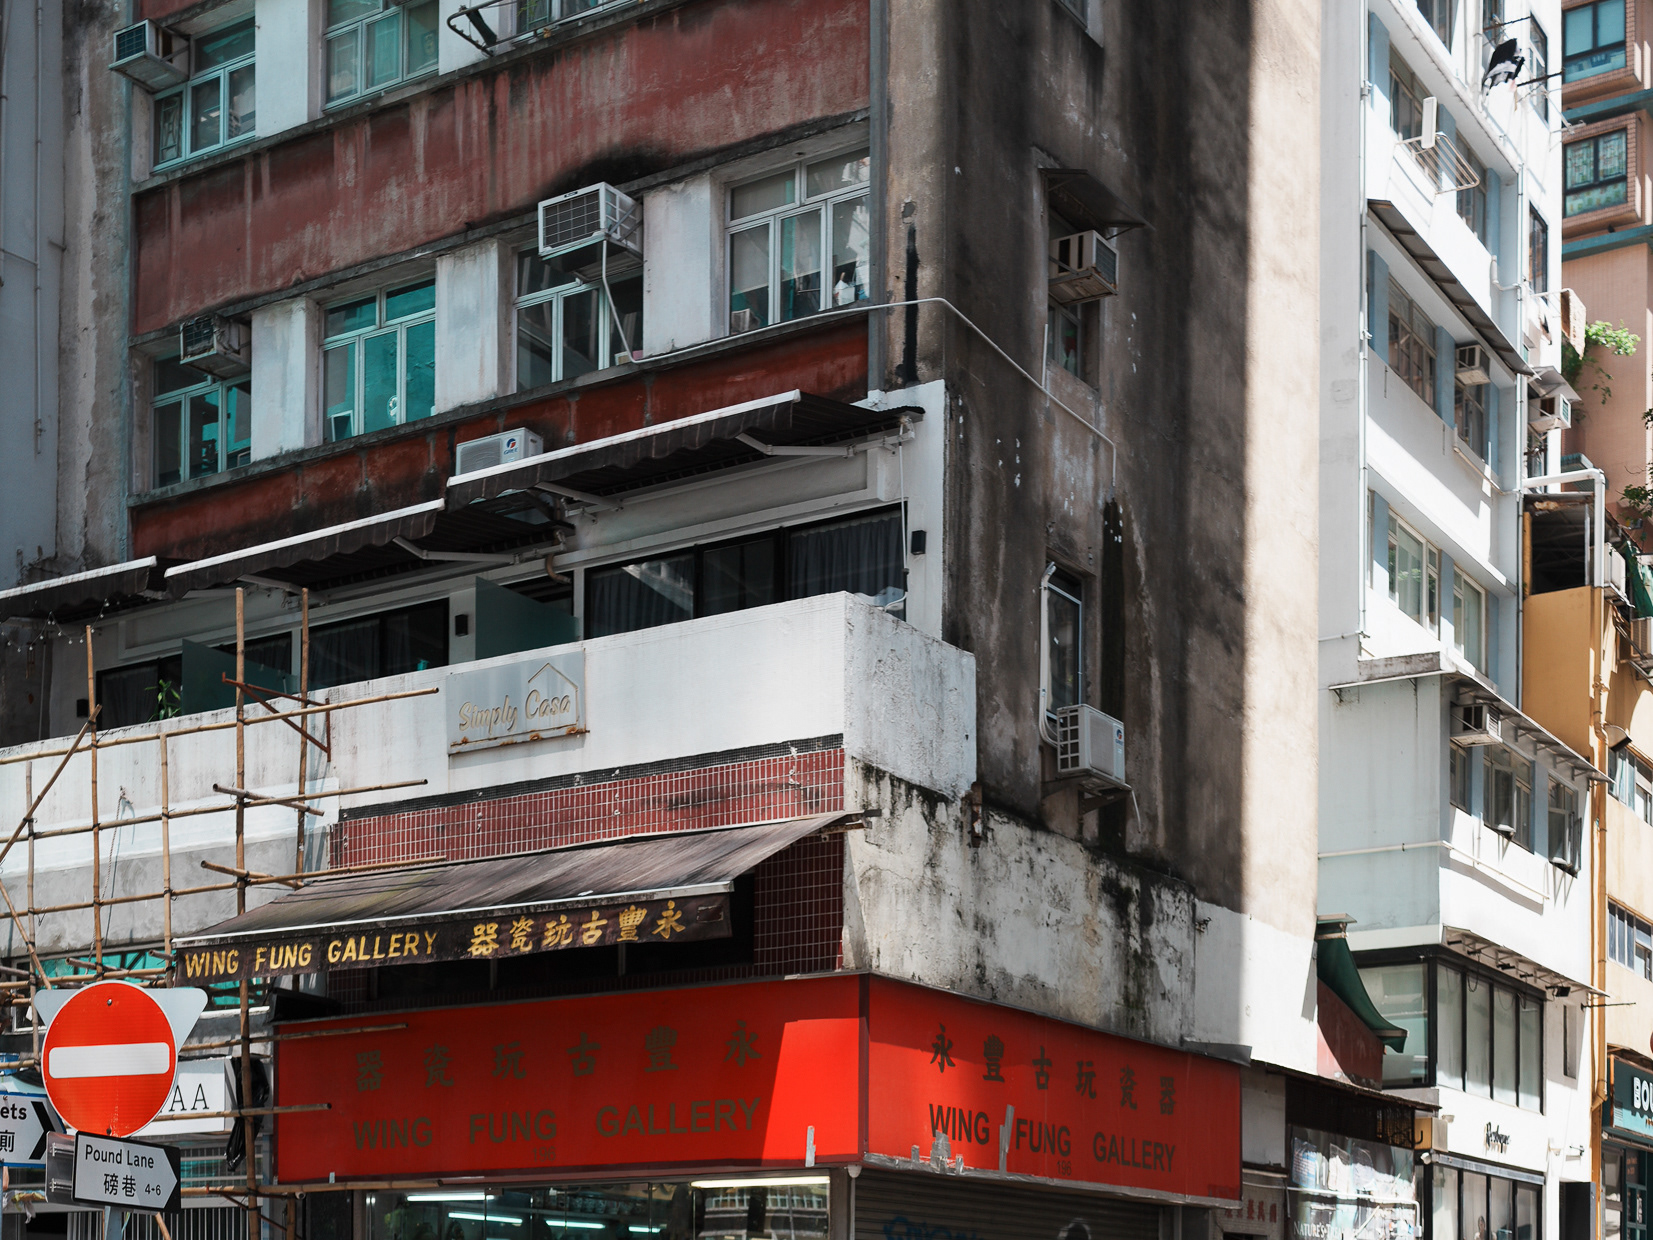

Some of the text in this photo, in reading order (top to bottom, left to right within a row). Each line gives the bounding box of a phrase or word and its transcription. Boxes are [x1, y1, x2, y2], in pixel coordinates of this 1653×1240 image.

[459, 689, 571, 735] Simply Casa
[185, 929, 440, 979] WING FUNG GALLERY
[929, 1023, 1176, 1115] 永豐古玩瓷器
[160, 1083, 209, 1112] AA
[353, 1097, 761, 1150] WING FUNG GALLERY
[929, 1103, 1176, 1173] WING FUNG GALLERY
[85, 1144, 154, 1168] Pound Lane
[532, 1147, 557, 1162] 196
[1056, 1160, 1072, 1176] 196
[104, 1173, 136, 1197] 磅巷
